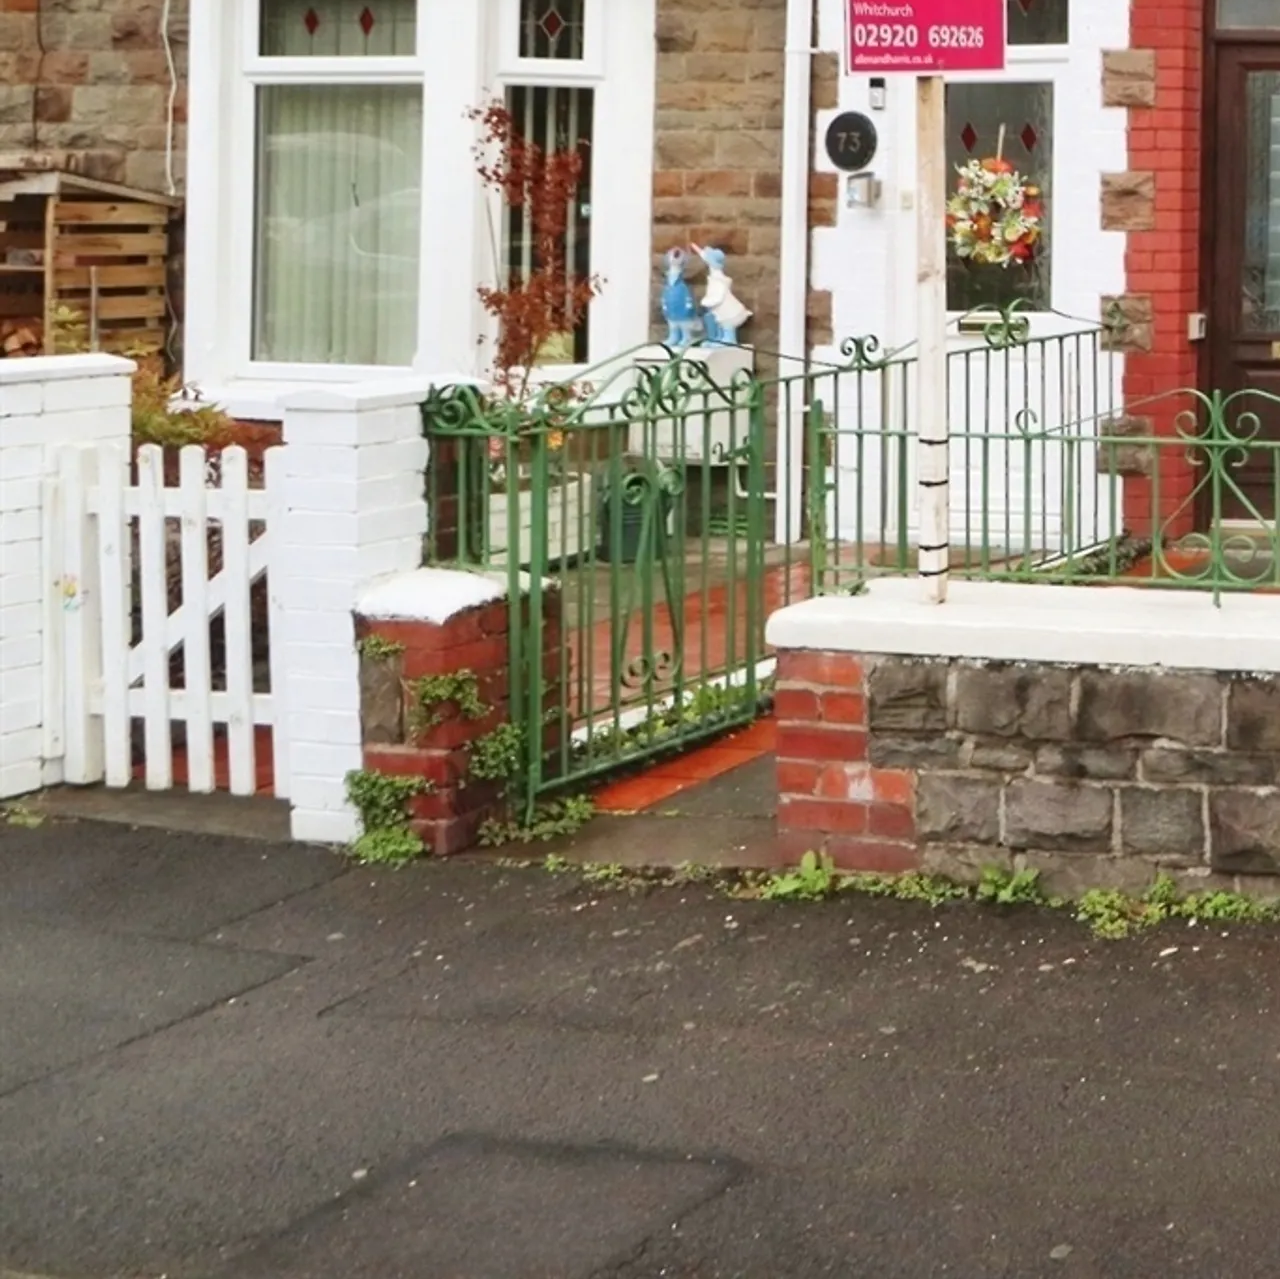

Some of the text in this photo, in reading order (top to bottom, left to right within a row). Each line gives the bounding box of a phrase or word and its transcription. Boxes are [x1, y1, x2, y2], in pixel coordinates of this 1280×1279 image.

[853, 2, 914, 17] Whitchurch
[854, 23, 985, 49] 02920 692626
[836, 131, 862, 153] 73
